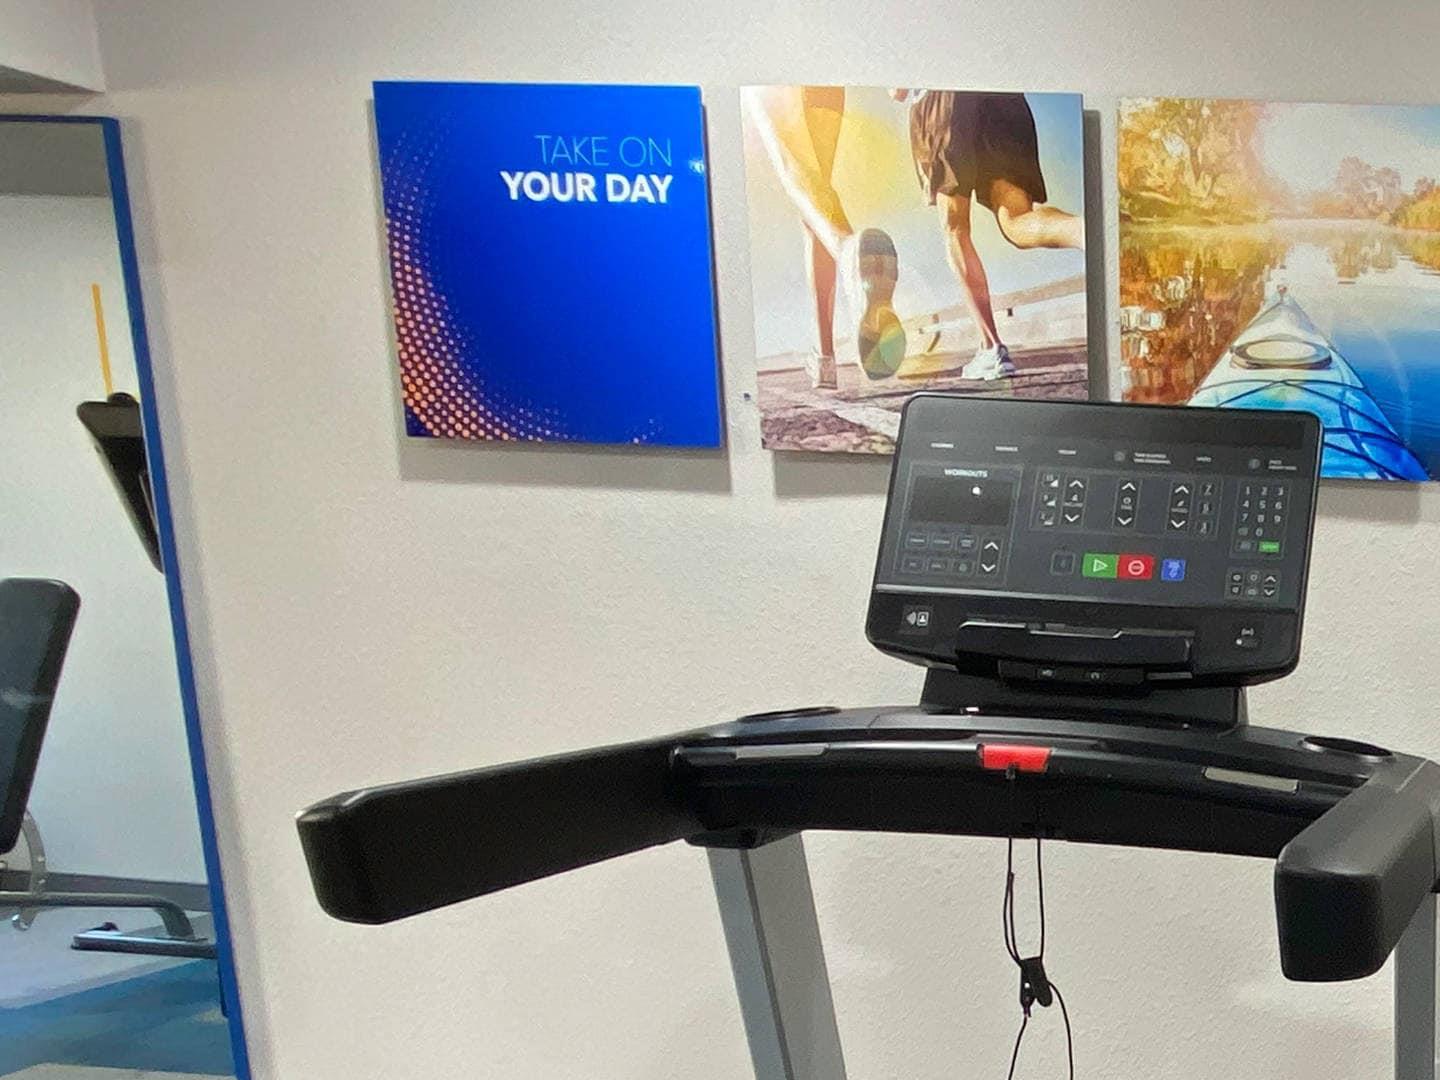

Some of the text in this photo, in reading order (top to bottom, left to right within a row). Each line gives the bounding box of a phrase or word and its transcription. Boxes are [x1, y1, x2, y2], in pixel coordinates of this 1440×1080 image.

[534, 134, 673, 168] TAKE ON
[500, 170, 674, 204] YOUR DAY
[1260, 486, 1268, 496] 2
[1277, 486, 1285, 496] 3
[1242, 499, 1283, 510] 4 5 6
[1241, 512, 1249, 522] 7
